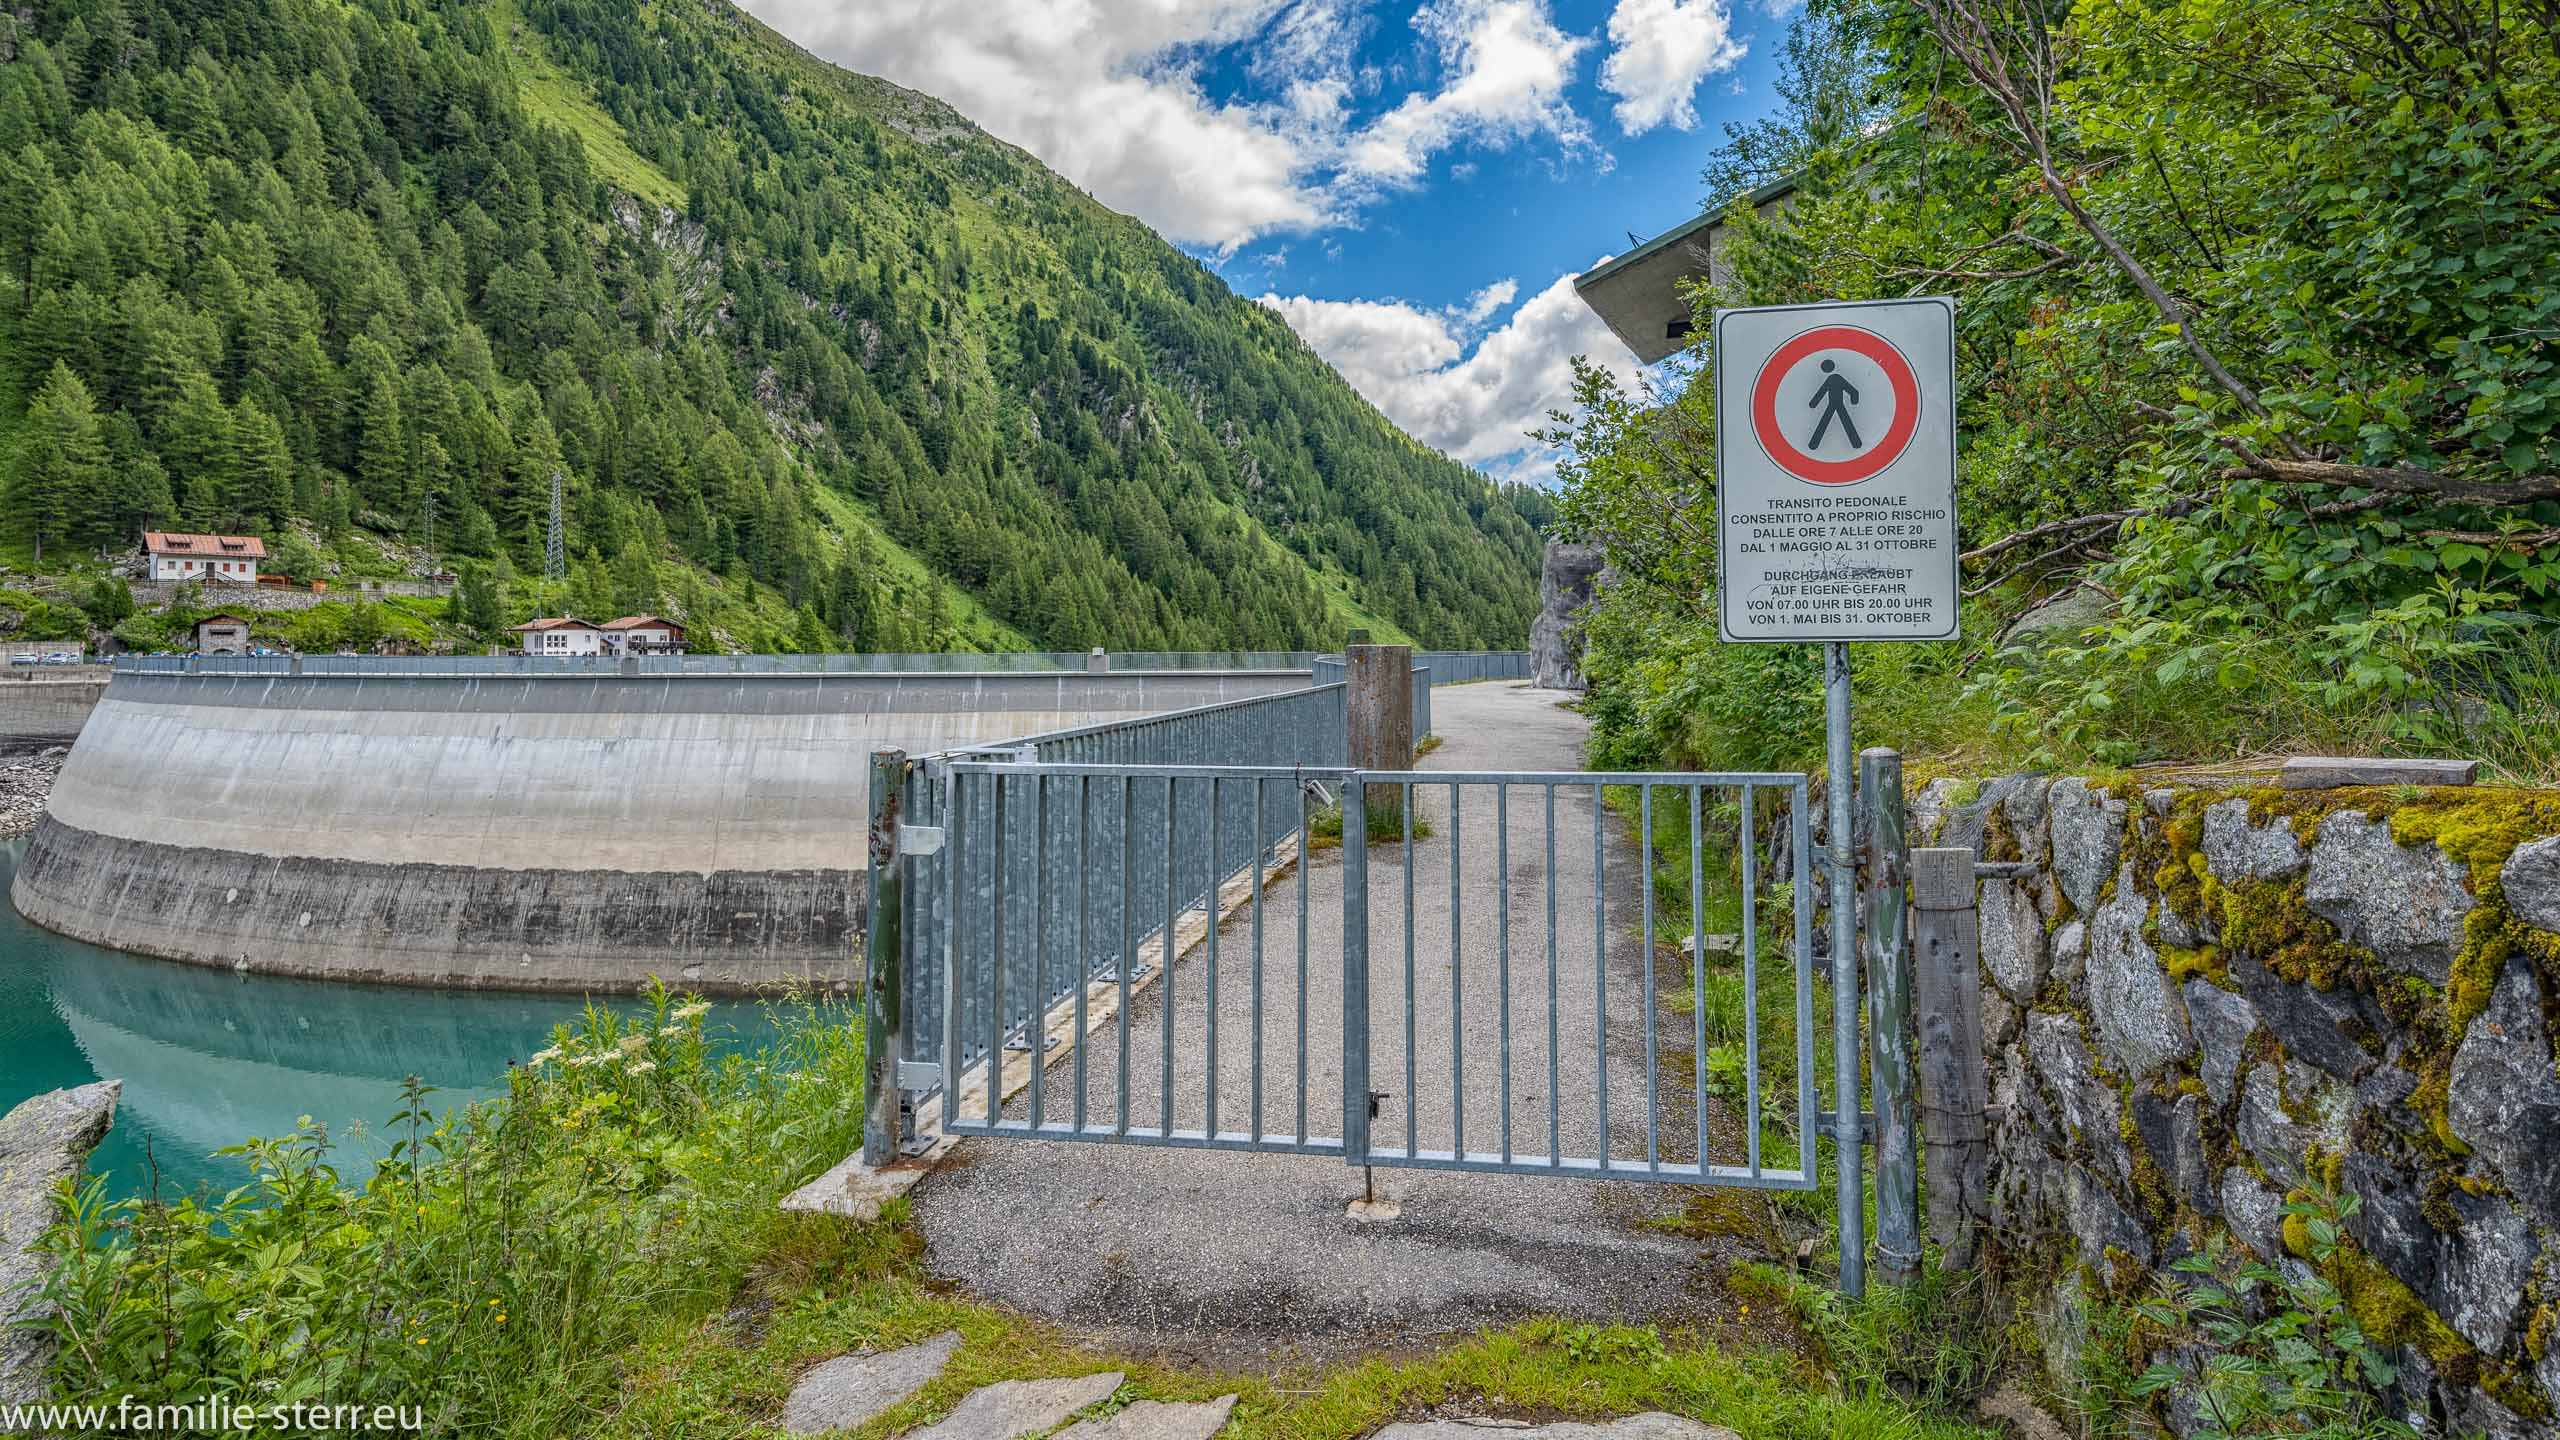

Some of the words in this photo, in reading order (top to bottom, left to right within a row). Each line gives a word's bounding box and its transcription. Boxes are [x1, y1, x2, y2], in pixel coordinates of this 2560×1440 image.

[1768, 498, 1832, 509] TRANSITO
[1836, 496, 1907, 507] PEDONALE
[1731, 513, 1813, 524] CONSENTITO
[1816, 513, 1825, 522] A
[1829, 512, 1888, 522] PROPRIO
[1891, 510, 1945, 520] RISCHIO
[1753, 528, 1794, 538] DALLE
[1799, 527, 1826, 537] ORE
[1830, 528, 1836, 536] 7
[1840, 527, 1873, 536] ALLE
[1877, 526, 1904, 535] ORE
[1908, 525, 1922, 535] 20
[1740, 543, 1765, 553] DAL
[1771, 543, 1775, 552] 1
[1780, 542, 1832, 552] MAGGIO
[1836, 542, 1851, 550] AL
[1856, 541, 1869, 550] 31
[1874, 540, 1936, 550] OTTOBRE
[1764, 570, 1849, 581] DURCHGANG
[1771, 586, 1797, 595] AUF
[1801, 585, 1849, 595] EIGENE
[1853, 584, 1906, 594] GEFAHR
[1747, 600, 1773, 610] VON
[1777, 600, 1808, 609] 07.00
[1812, 599, 1839, 609] UHR
[1844, 599, 1864, 608] BIS
[1869, 599, 1901, 608] 20.00
[1904, 598, 1932, 608] UHR
[1749, 615, 1776, 624] VON
[1780, 615, 1789, 624] 1.
[1794, 614, 1816, 623] MAI
[1821, 614, 1841, 623] BIS
[1845, 614, 1862, 623] 31.
[1867, 613, 1931, 623] OKTOBER
